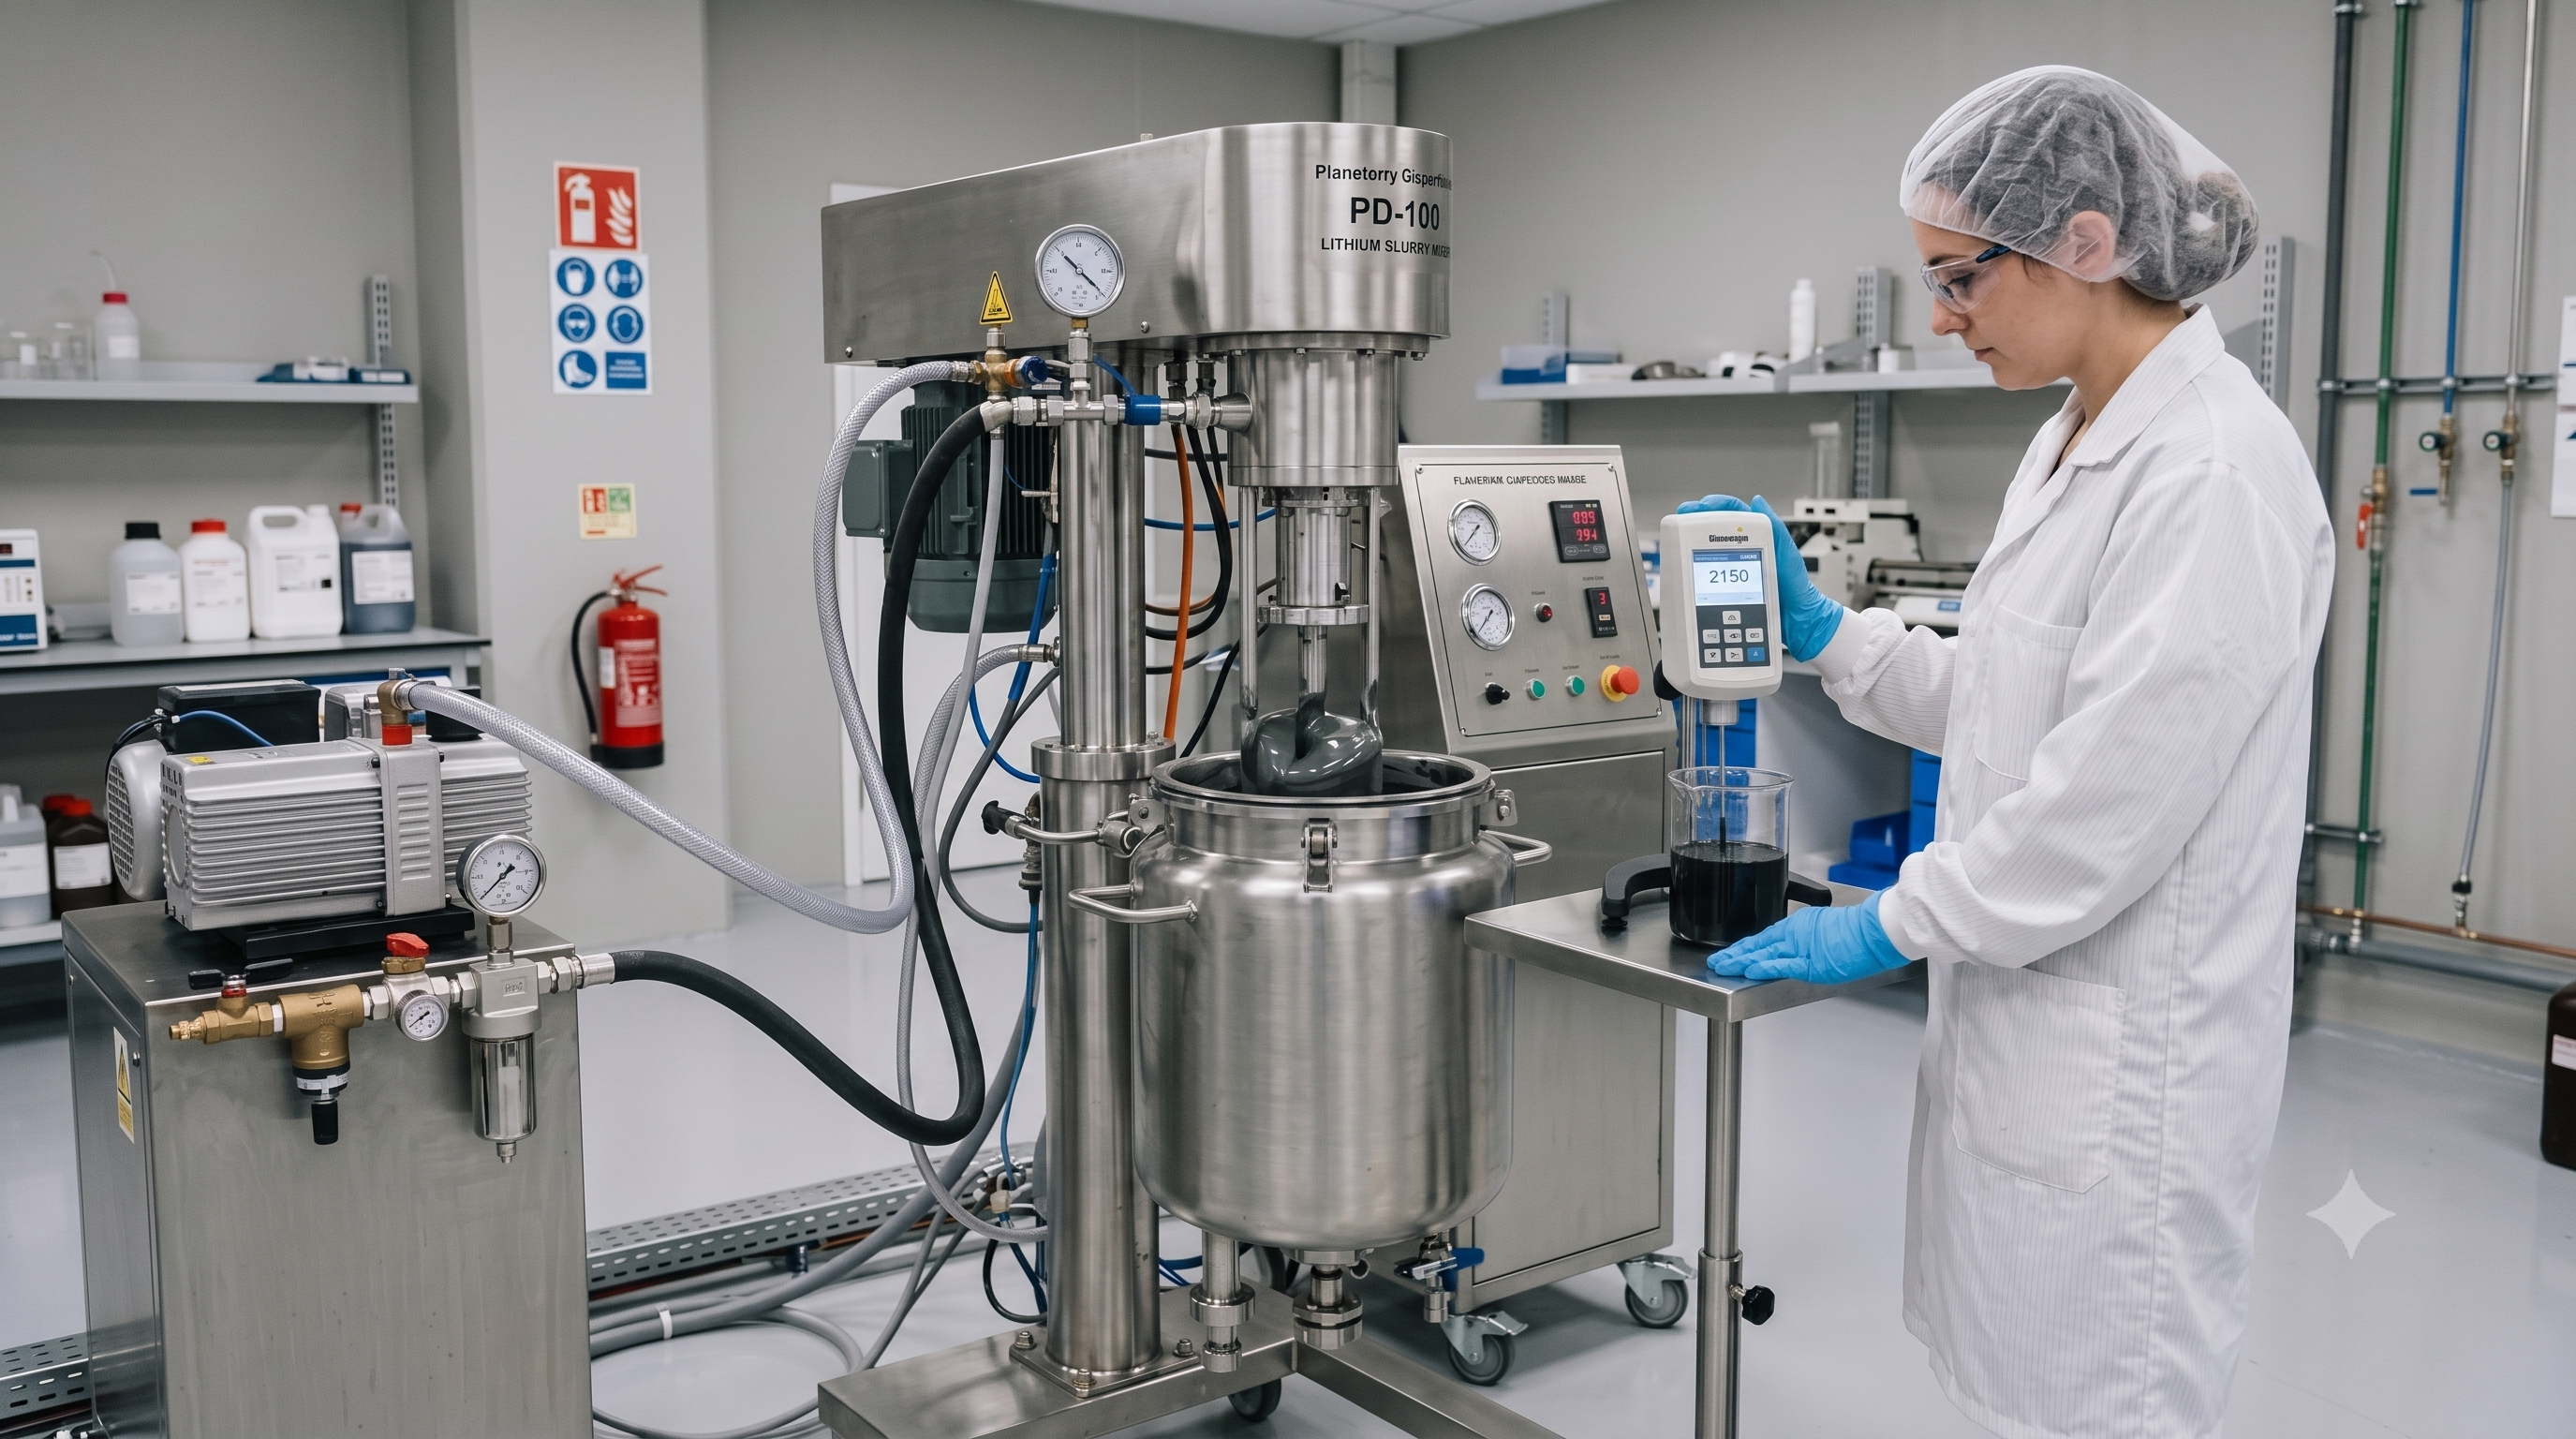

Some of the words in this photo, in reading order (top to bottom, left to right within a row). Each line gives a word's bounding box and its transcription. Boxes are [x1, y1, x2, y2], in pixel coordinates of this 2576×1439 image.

[1315, 164, 1398, 185] Planetorry
[1350, 197, 1440, 230] PD-100
[1321, 237, 1381, 252] LITHIUM
[1384, 240, 1431, 255] SLURRY
[1709, 569, 1749, 584] 2150
[1598, 591, 1606, 605] 3
